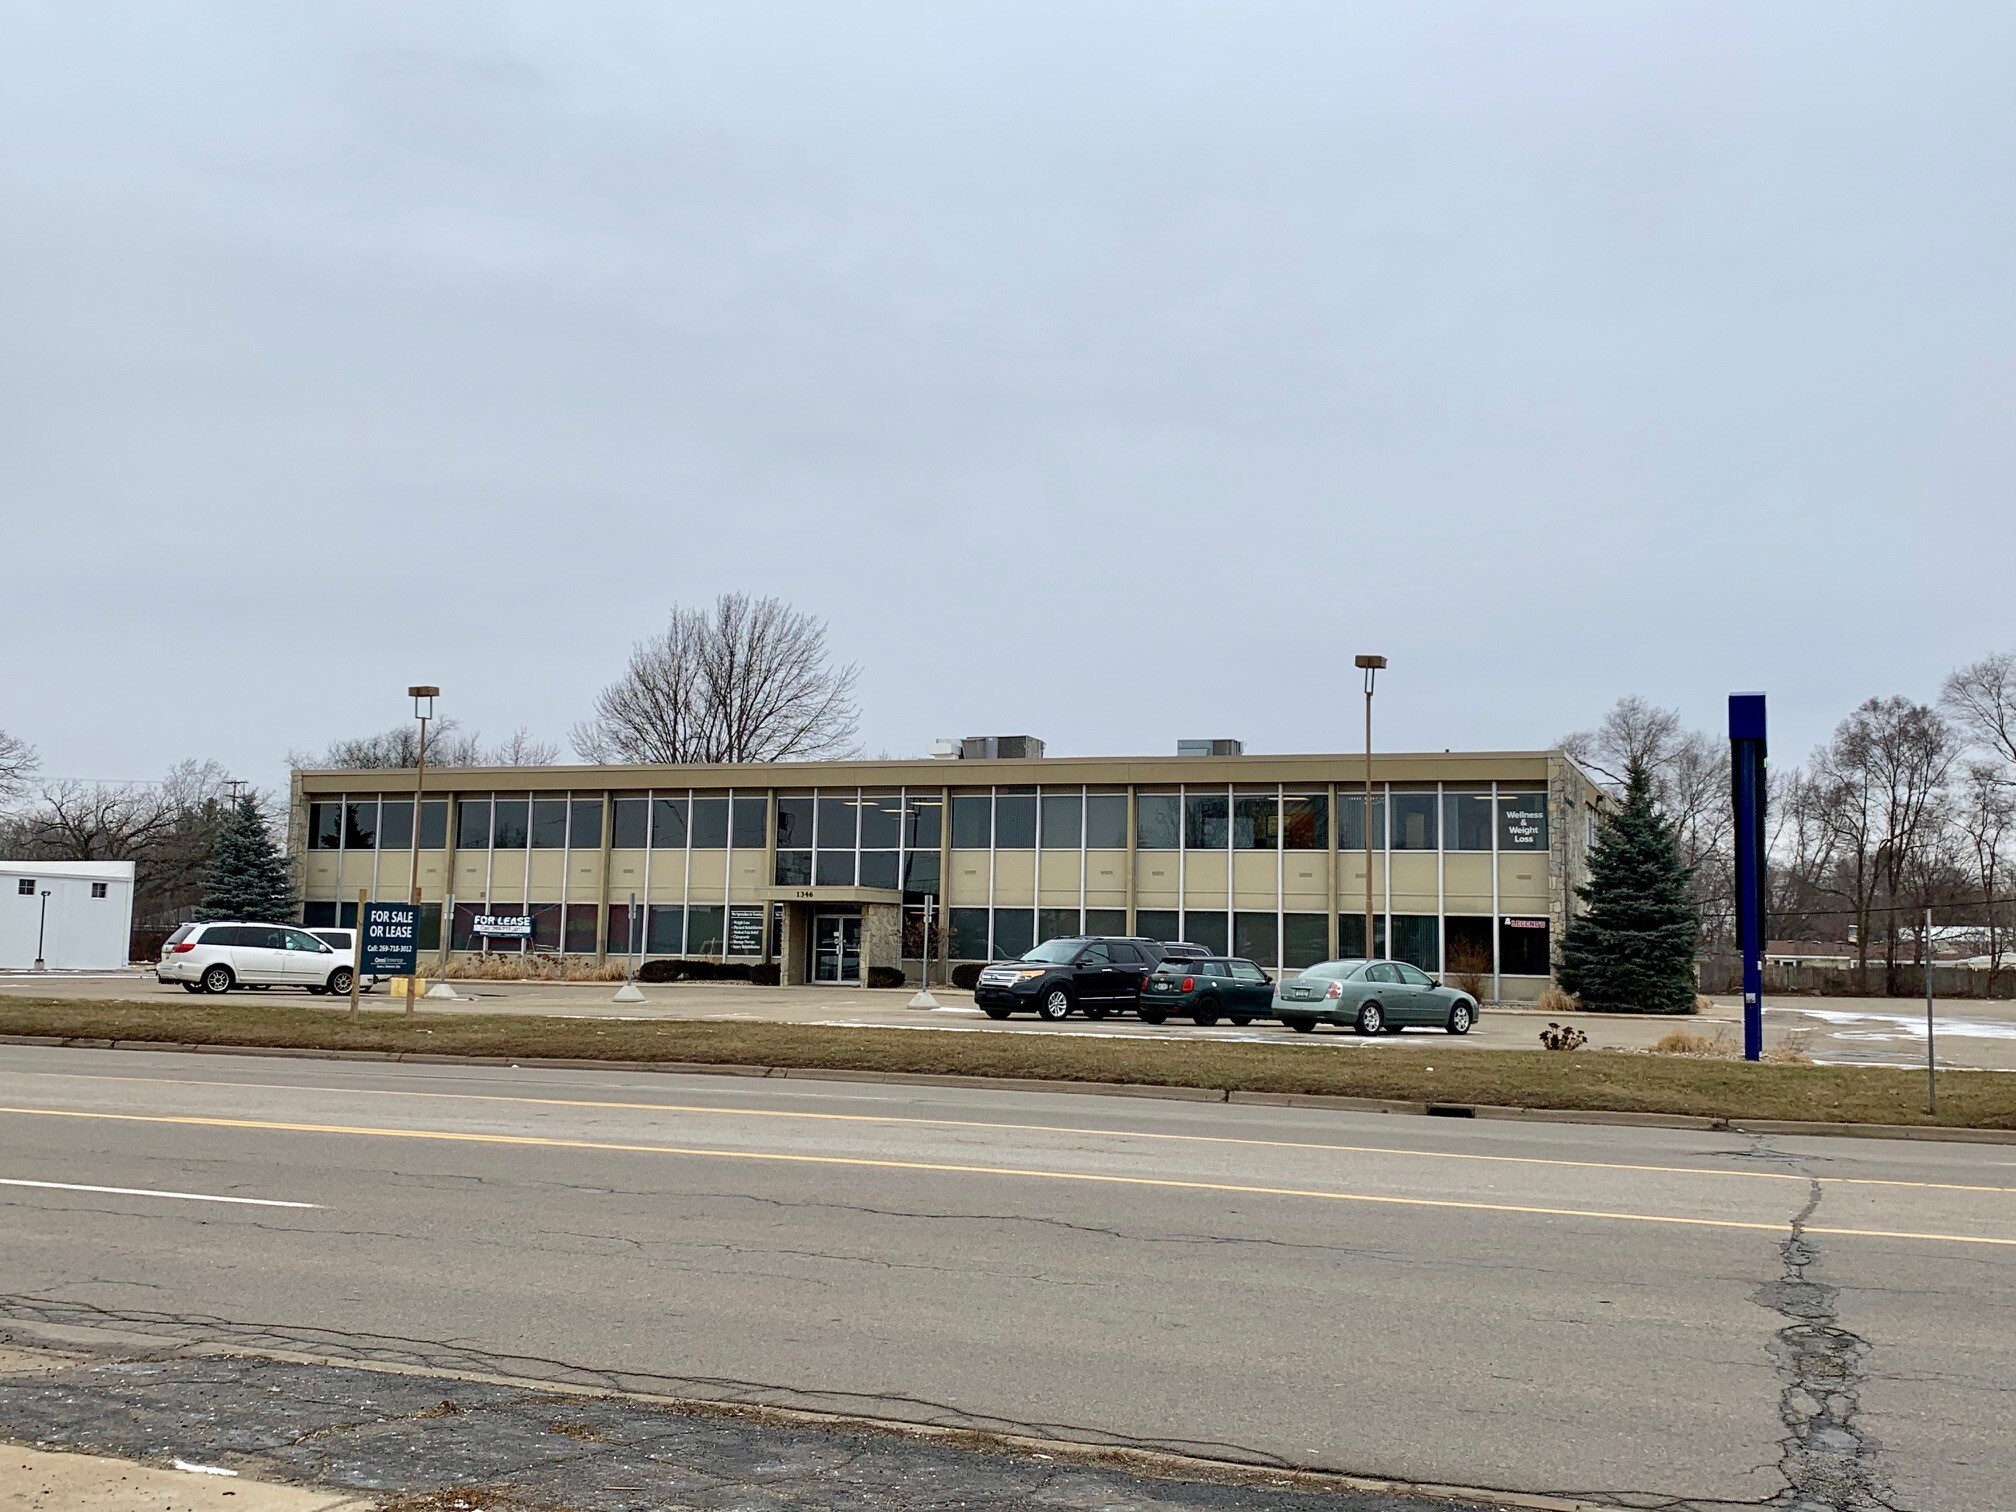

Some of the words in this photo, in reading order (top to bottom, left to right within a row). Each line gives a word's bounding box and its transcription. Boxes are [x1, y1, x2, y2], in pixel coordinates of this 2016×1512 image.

[1506, 811, 1543, 819] Wellness
[1508, 826, 1539, 835] Weight
[1514, 835, 1534, 843] Loss
[371, 910, 389, 922] FOR
[391, 911, 413, 923] SALE
[474, 915, 496, 925] FOR
[497, 916, 531, 926] LEASE
[369, 925, 384, 937] OR
[385, 926, 412, 938] LEASE
[379, 945, 412, 953] 269-718-3012
